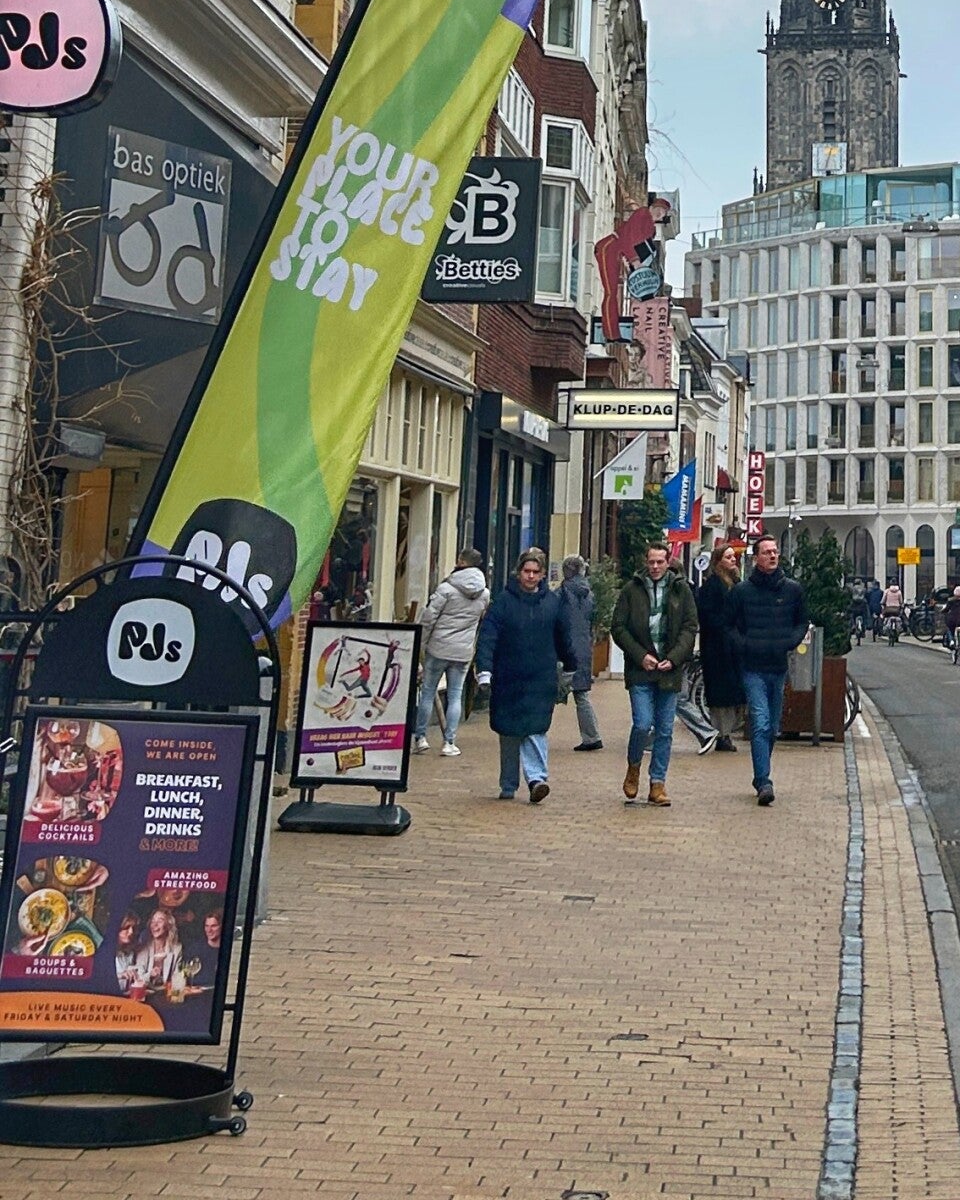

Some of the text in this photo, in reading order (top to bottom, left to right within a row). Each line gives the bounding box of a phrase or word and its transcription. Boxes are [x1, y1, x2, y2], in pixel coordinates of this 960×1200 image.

[113, 134, 225, 196] bas optiek
[325, 116, 439, 204] YOUR
[301, 154, 434, 245] PLACE
[296, 195, 348, 254] TO
[270, 235, 378, 311] STAY
[443, 260, 518, 279] Betties
[645, 306, 653, 333] NAIL
[657, 306, 667, 359] CREATIVE
[748, 454, 762, 534] HOEK
[118, 620, 182, 662] PJs
[145, 739, 216, 750] COME INSIDE,
[146, 750, 217, 761] WE ARE OPEN
[135, 773, 223, 790] BREAKFAST,
[150, 790, 204, 806] LUNCH,
[144, 806, 204, 822] DINNER,
[41, 823, 94, 832] DELICIOUS
[145, 823, 202, 836] DRINKS
[38, 833, 95, 841] COCKTAILS
[139, 838, 150, 850] &
[164, 871, 209, 880] AMAZING
[154, 880, 217, 889] STREETFOOD
[33, 958, 76, 967] SOUPS &
[25, 967, 84, 976] BAGUETTES
[28, 1003, 50, 1011] LIVE
[90, 1004, 122, 1012] EVERY
[4, 1013, 41, 1021] FRIDAY
[54, 1013, 109, 1022] SATURDAY
[112, 1014, 143, 1022] NIGHT
